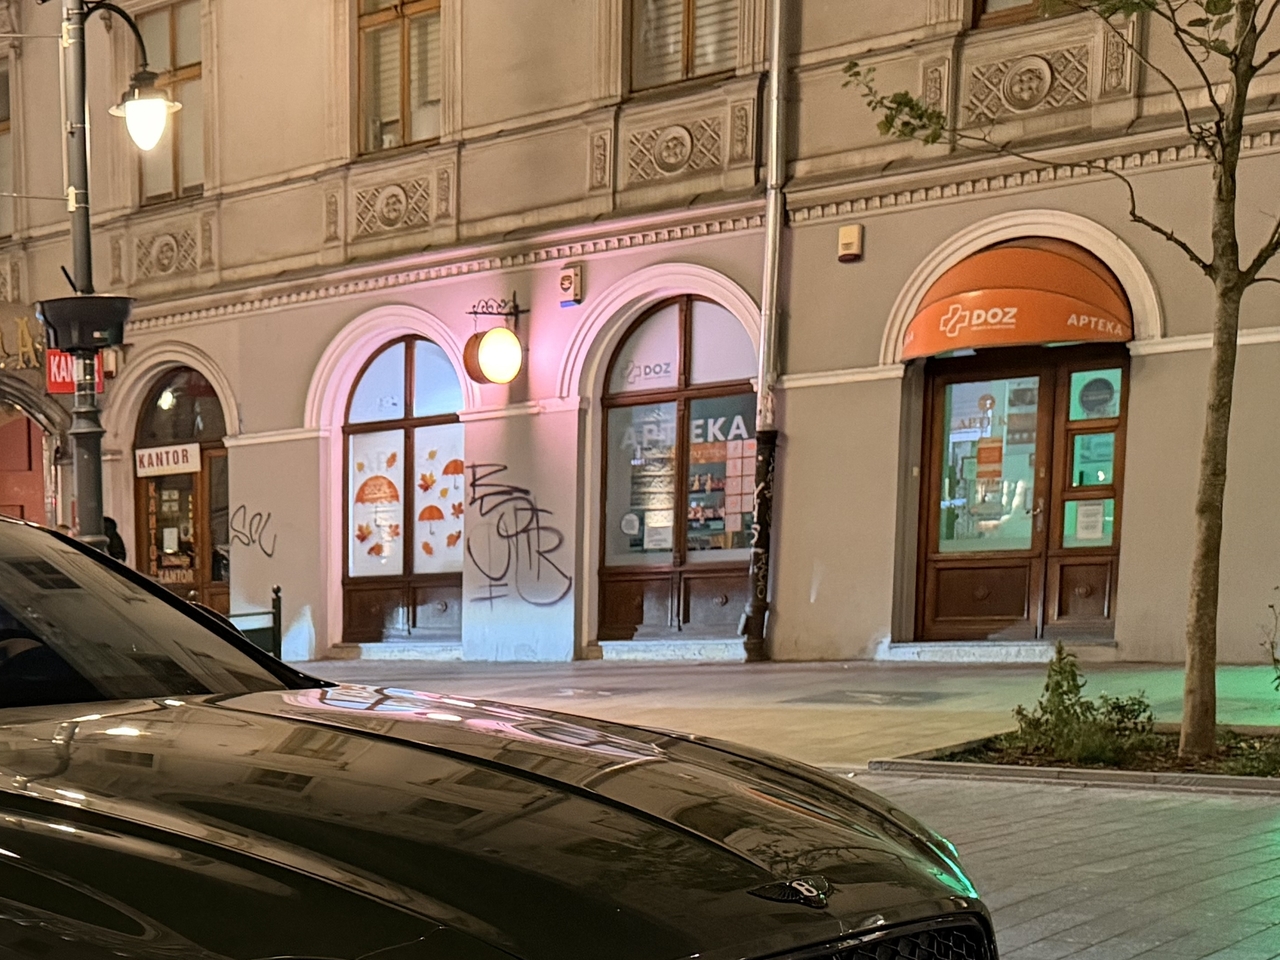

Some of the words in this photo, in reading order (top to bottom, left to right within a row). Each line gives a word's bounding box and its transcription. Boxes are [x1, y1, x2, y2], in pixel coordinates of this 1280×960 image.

[971, 307, 1017, 325] DOZ
[1066, 313, 1123, 337] APTEKA
[644, 362, 671, 376] DOZ
[138, 448, 189, 469] KANTOR
